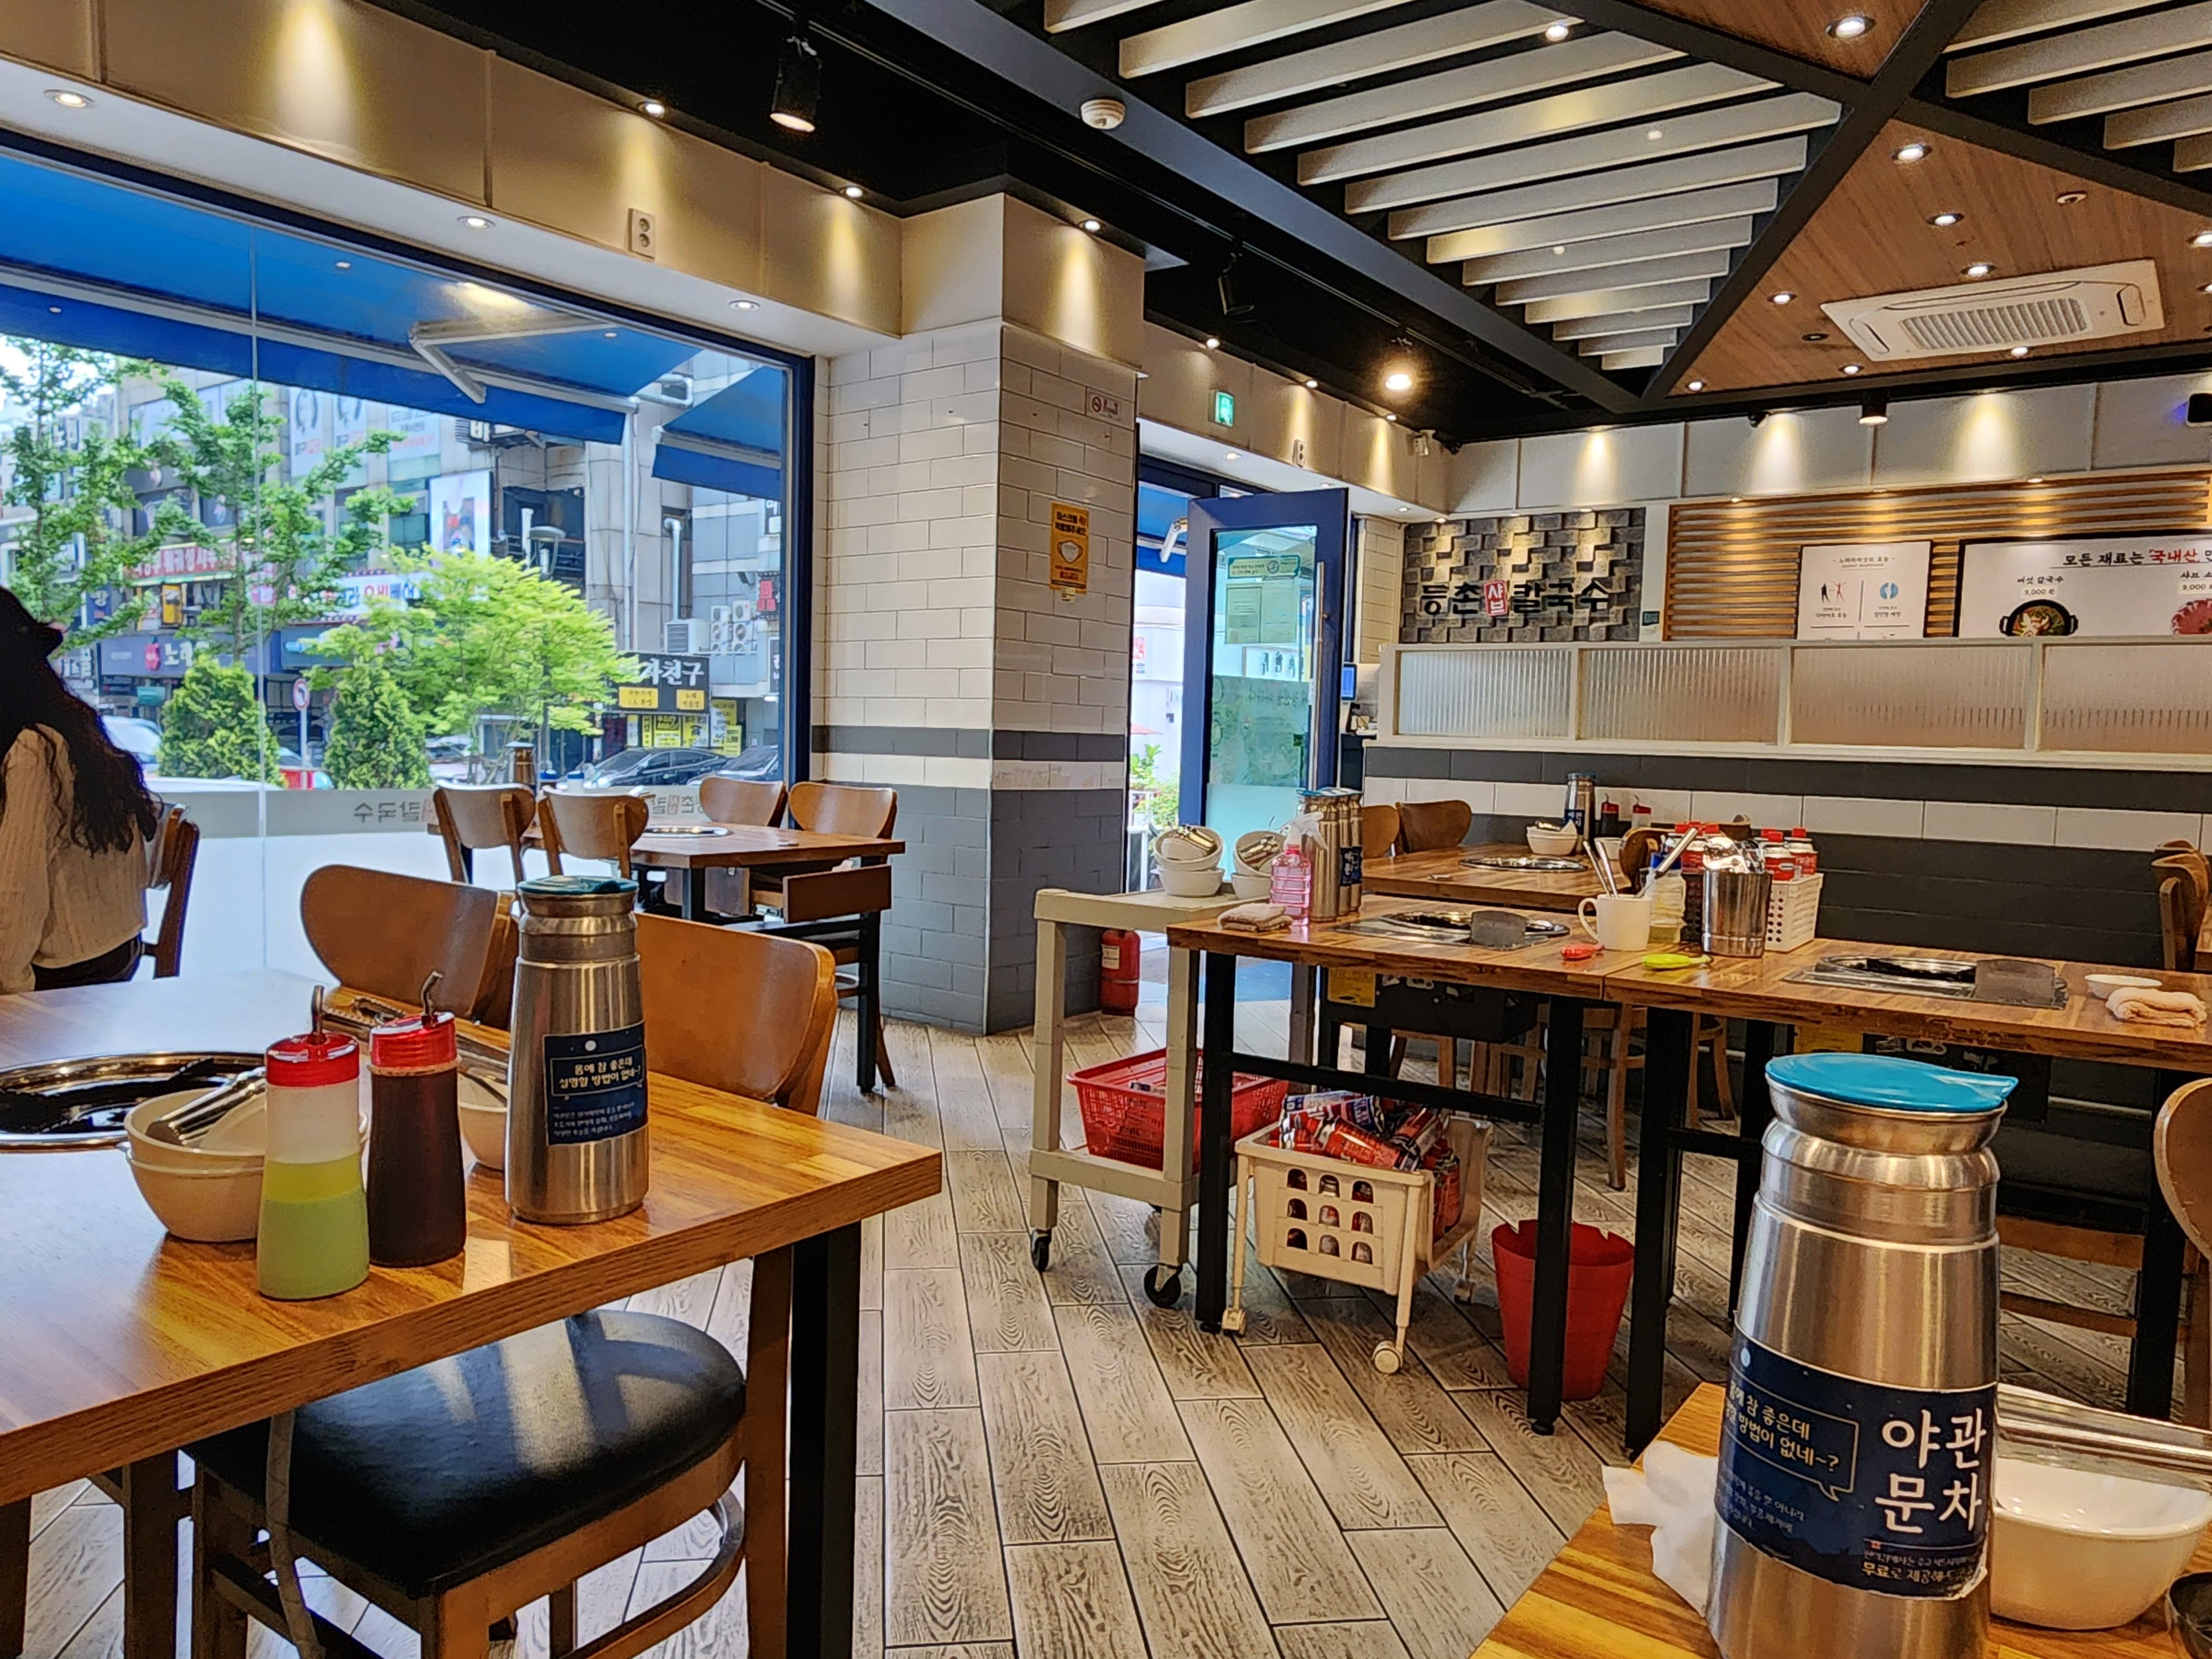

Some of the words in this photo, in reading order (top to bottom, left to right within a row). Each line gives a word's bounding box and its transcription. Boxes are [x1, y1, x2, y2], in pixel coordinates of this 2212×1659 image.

[2063, 552, 2093, 567] 모든
[2098, 550, 2145, 565] 재료는
[1738, 1411, 1775, 1449] 방법이
[1746, 1394, 1759, 1417] 참
[1762, 1405, 1811, 1441] 좋은데
[1881, 1407, 1986, 1469] 야관
[1875, 1472, 1983, 1535] 문차
[1861, 1561, 1902, 1579] 무료로
